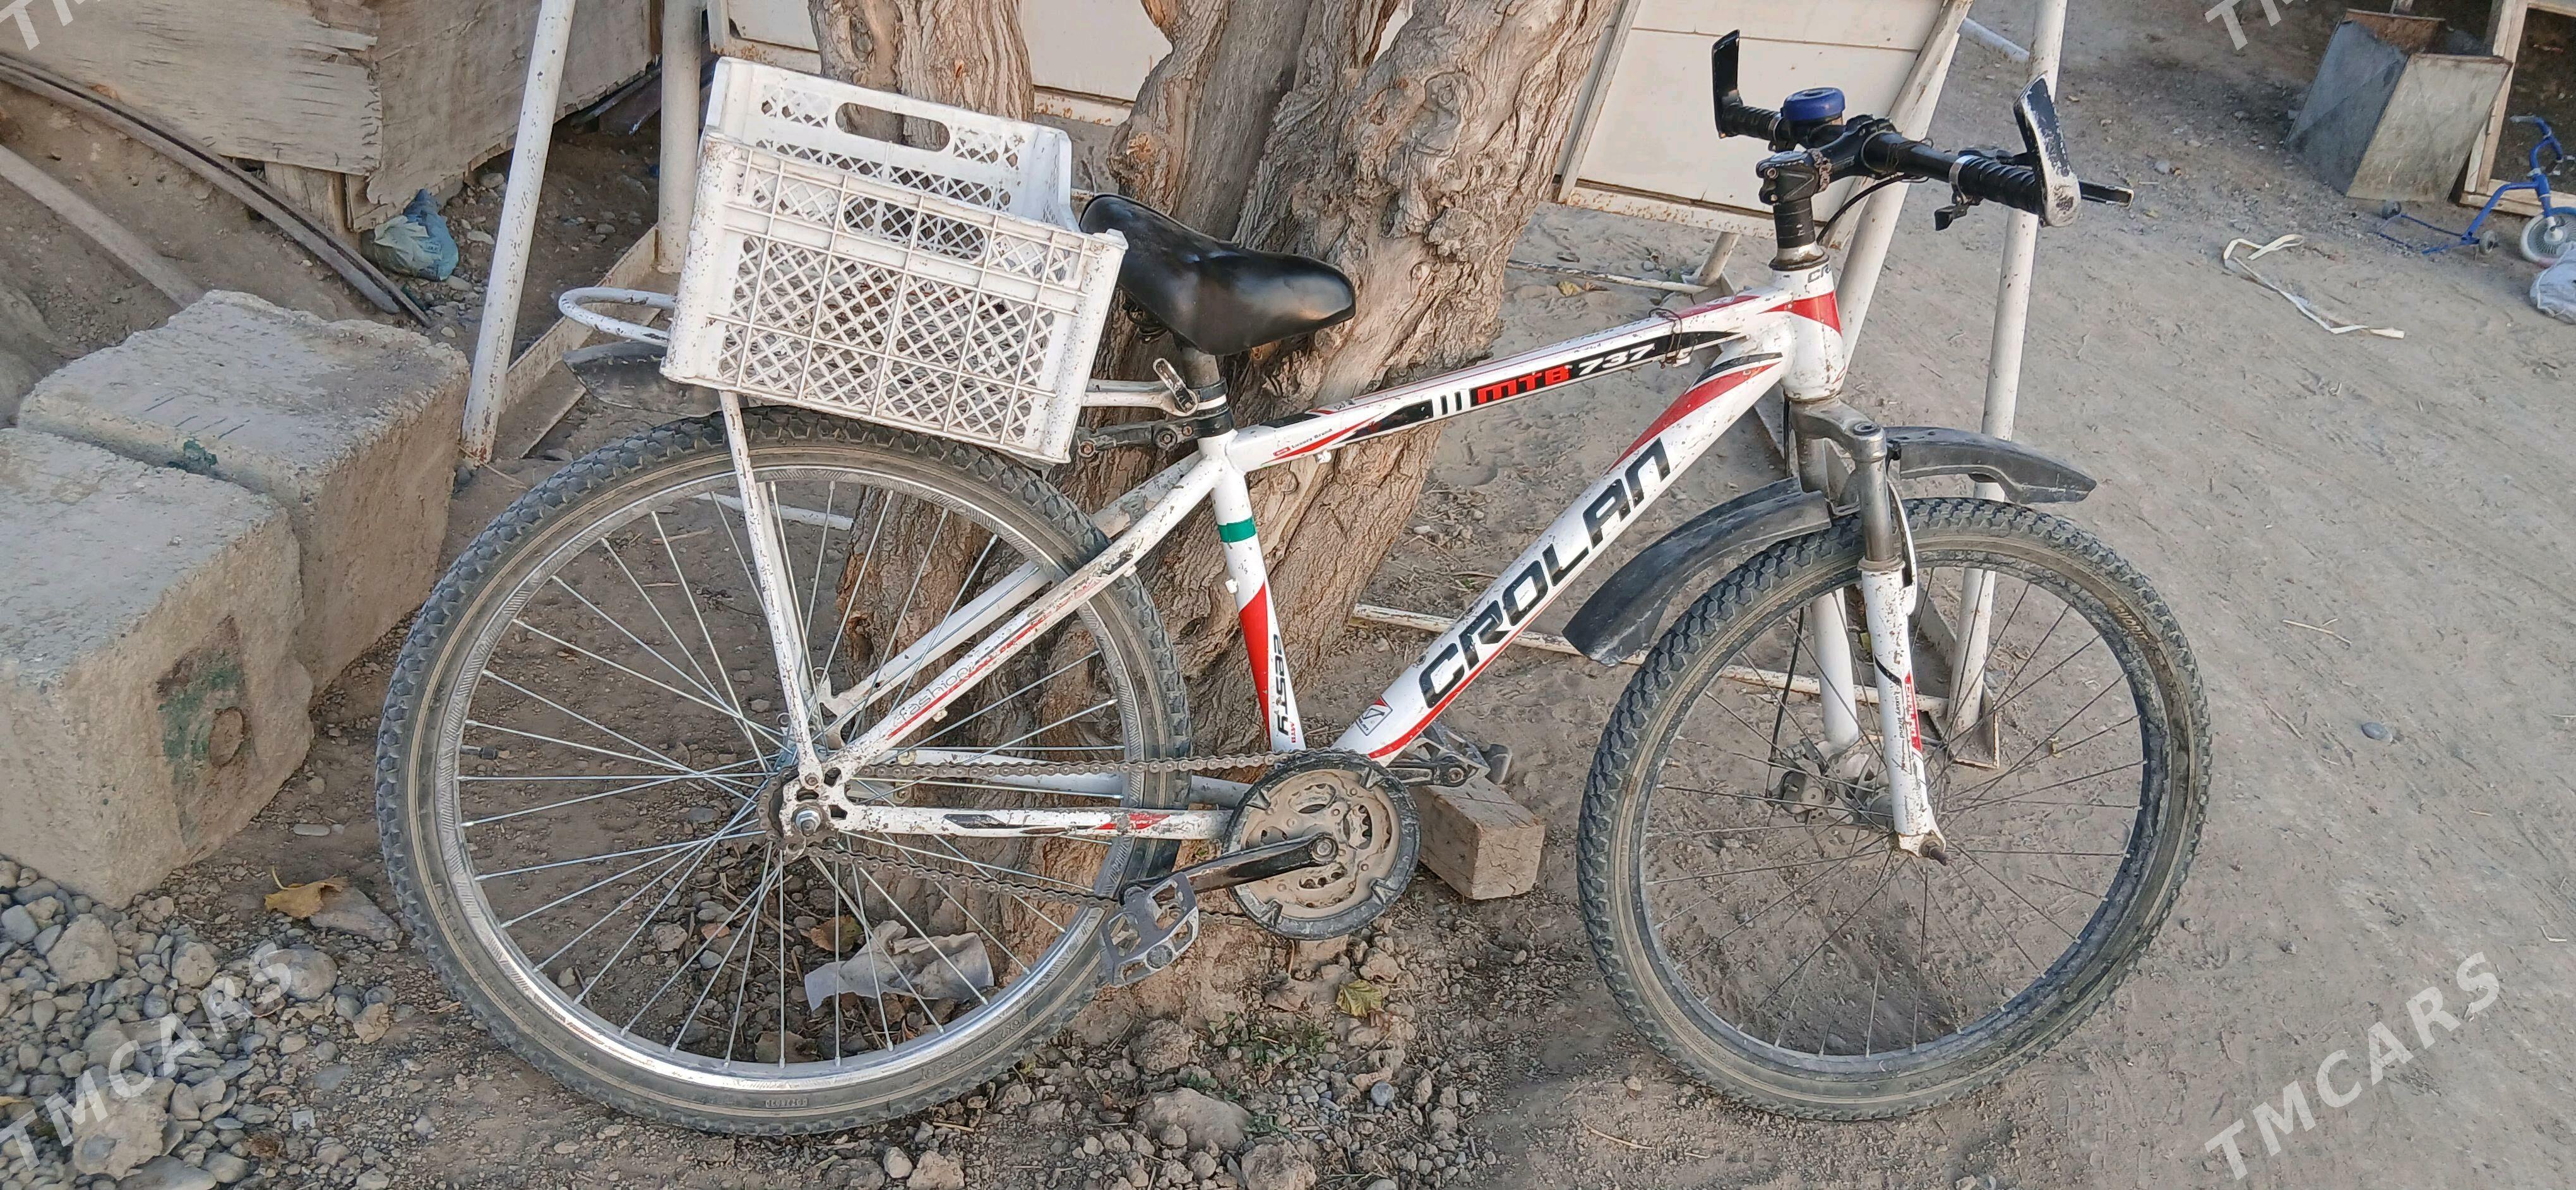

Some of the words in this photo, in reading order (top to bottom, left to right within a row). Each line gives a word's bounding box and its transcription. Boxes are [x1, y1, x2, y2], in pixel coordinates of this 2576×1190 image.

[1477, 364, 1570, 404] MTB
[1578, 343, 1655, 376] 737
[1419, 437, 1671, 709] CROLAN
